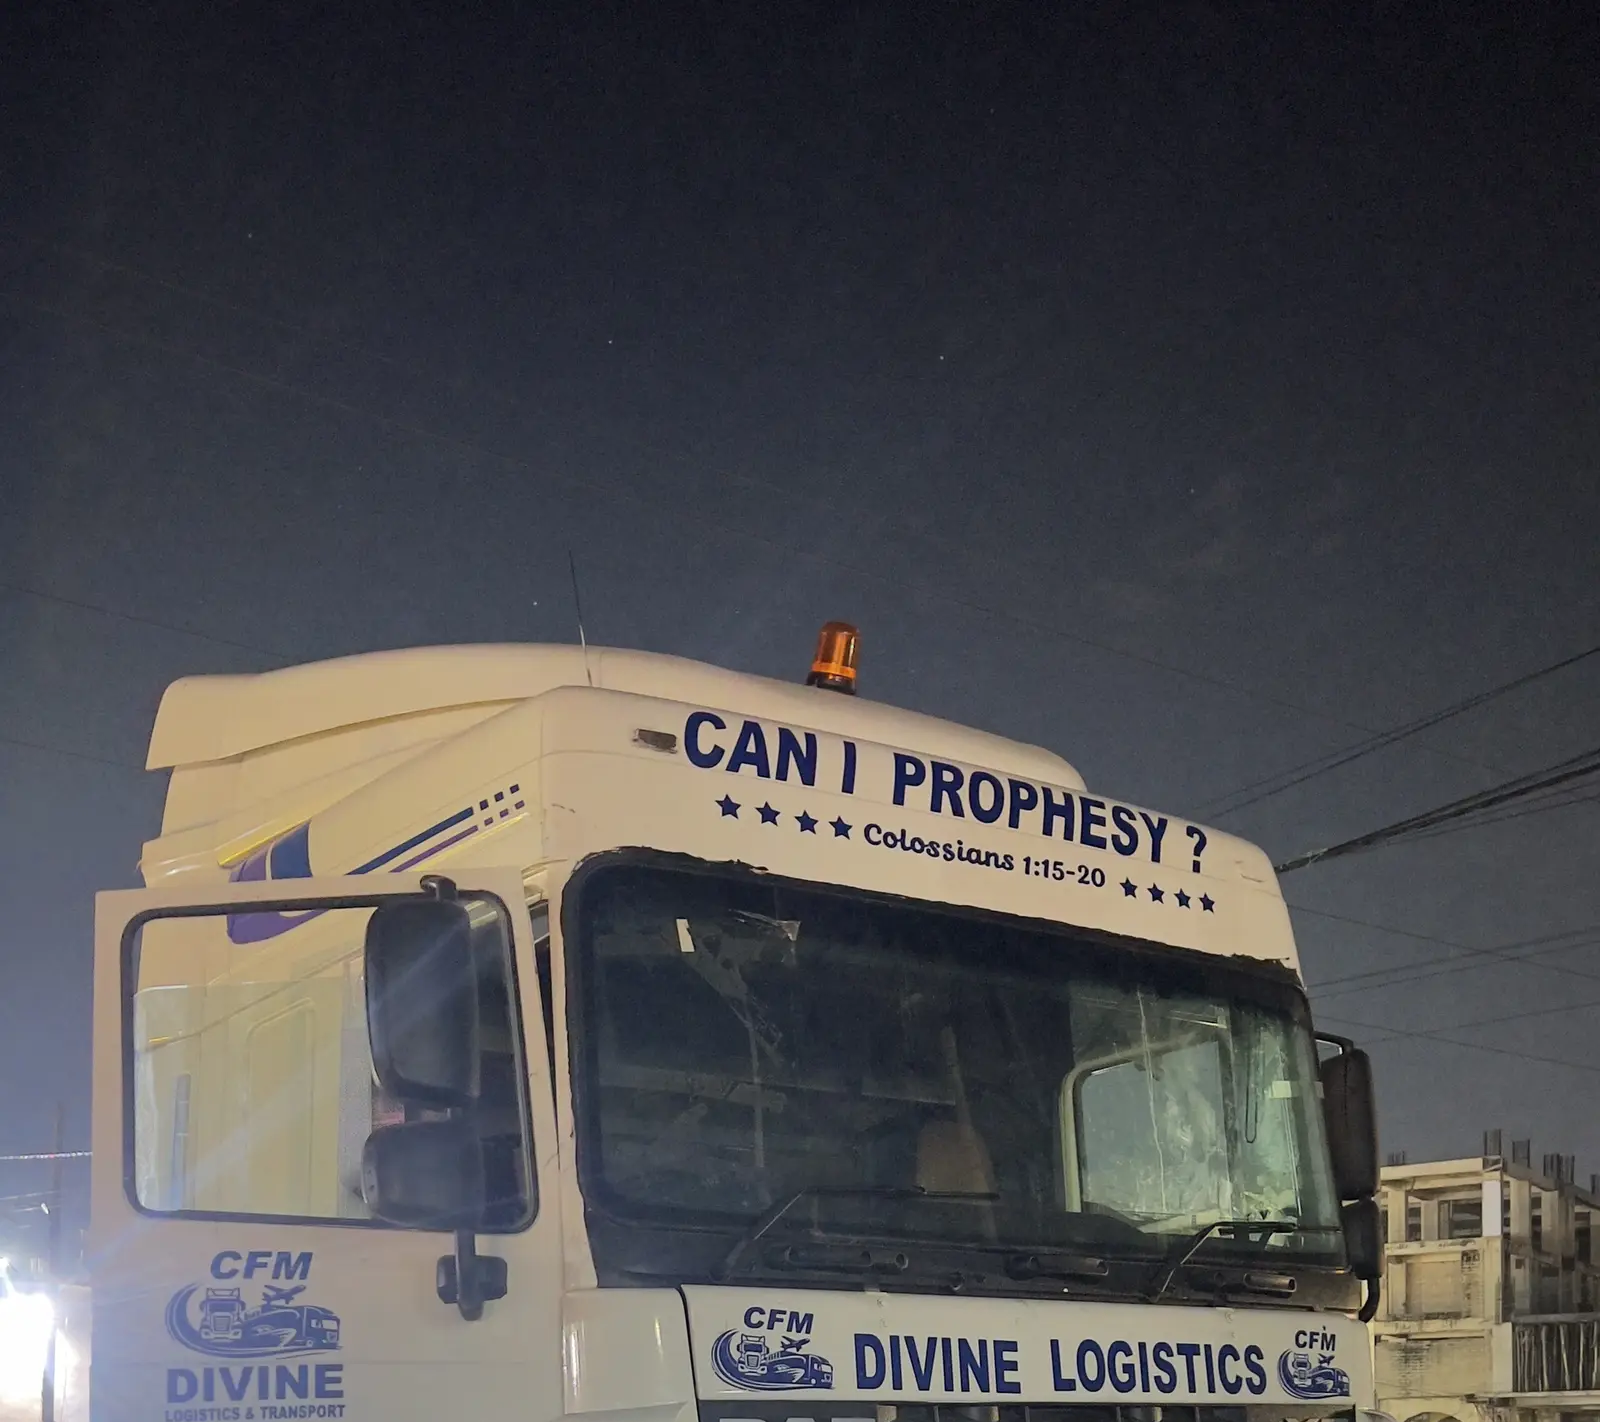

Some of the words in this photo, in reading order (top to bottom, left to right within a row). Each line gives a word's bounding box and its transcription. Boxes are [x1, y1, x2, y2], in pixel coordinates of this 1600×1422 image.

[684, 712, 817, 786] CAN
[841, 741, 857, 795] I
[892, 752, 1169, 863] PROPHESY
[1186, 825, 1208, 873] ?
[863, 823, 1014, 872] Colossians
[1022, 855, 1107, 888] 1:15-20
[210, 1251, 314, 1280] CFM
[743, 1306, 814, 1335] CFM
[1294, 1329, 1337, 1352] CFM
[854, 1333, 1022, 1394] DIVINE
[1051, 1339, 1267, 1396] LOGISTICS
[166, 1364, 345, 1404] DIVINE
[245, 1406, 255, 1420] &
[260, 1404, 346, 1420] TRANSPORT
